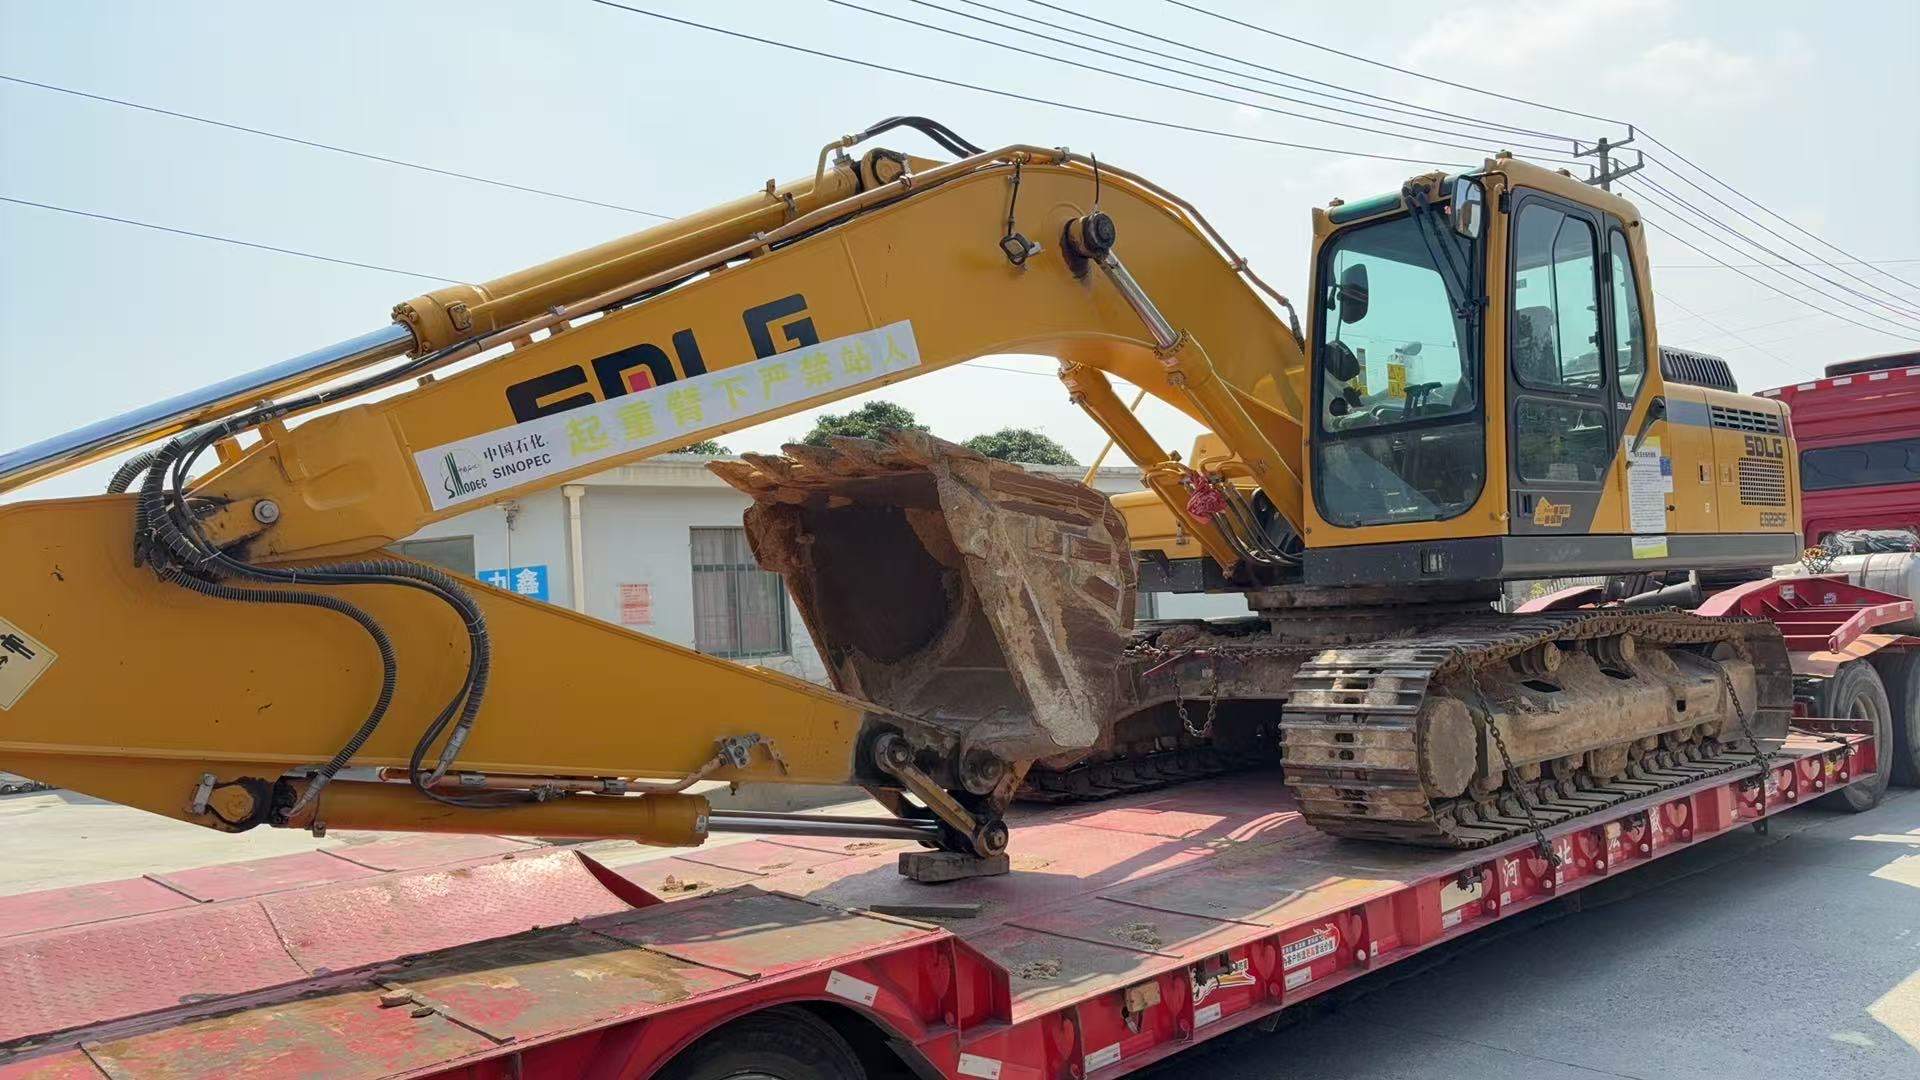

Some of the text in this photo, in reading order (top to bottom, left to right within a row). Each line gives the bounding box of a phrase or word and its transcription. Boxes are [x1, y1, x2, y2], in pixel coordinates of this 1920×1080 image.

[566, 331, 908, 457] 起重臂下严禁站人
[1616, 401, 1633, 411] SDLG
[483, 433, 546, 463] 中国石化
[1744, 433, 1784, 459] SDLG
[493, 453, 552, 479] SINOPEC
